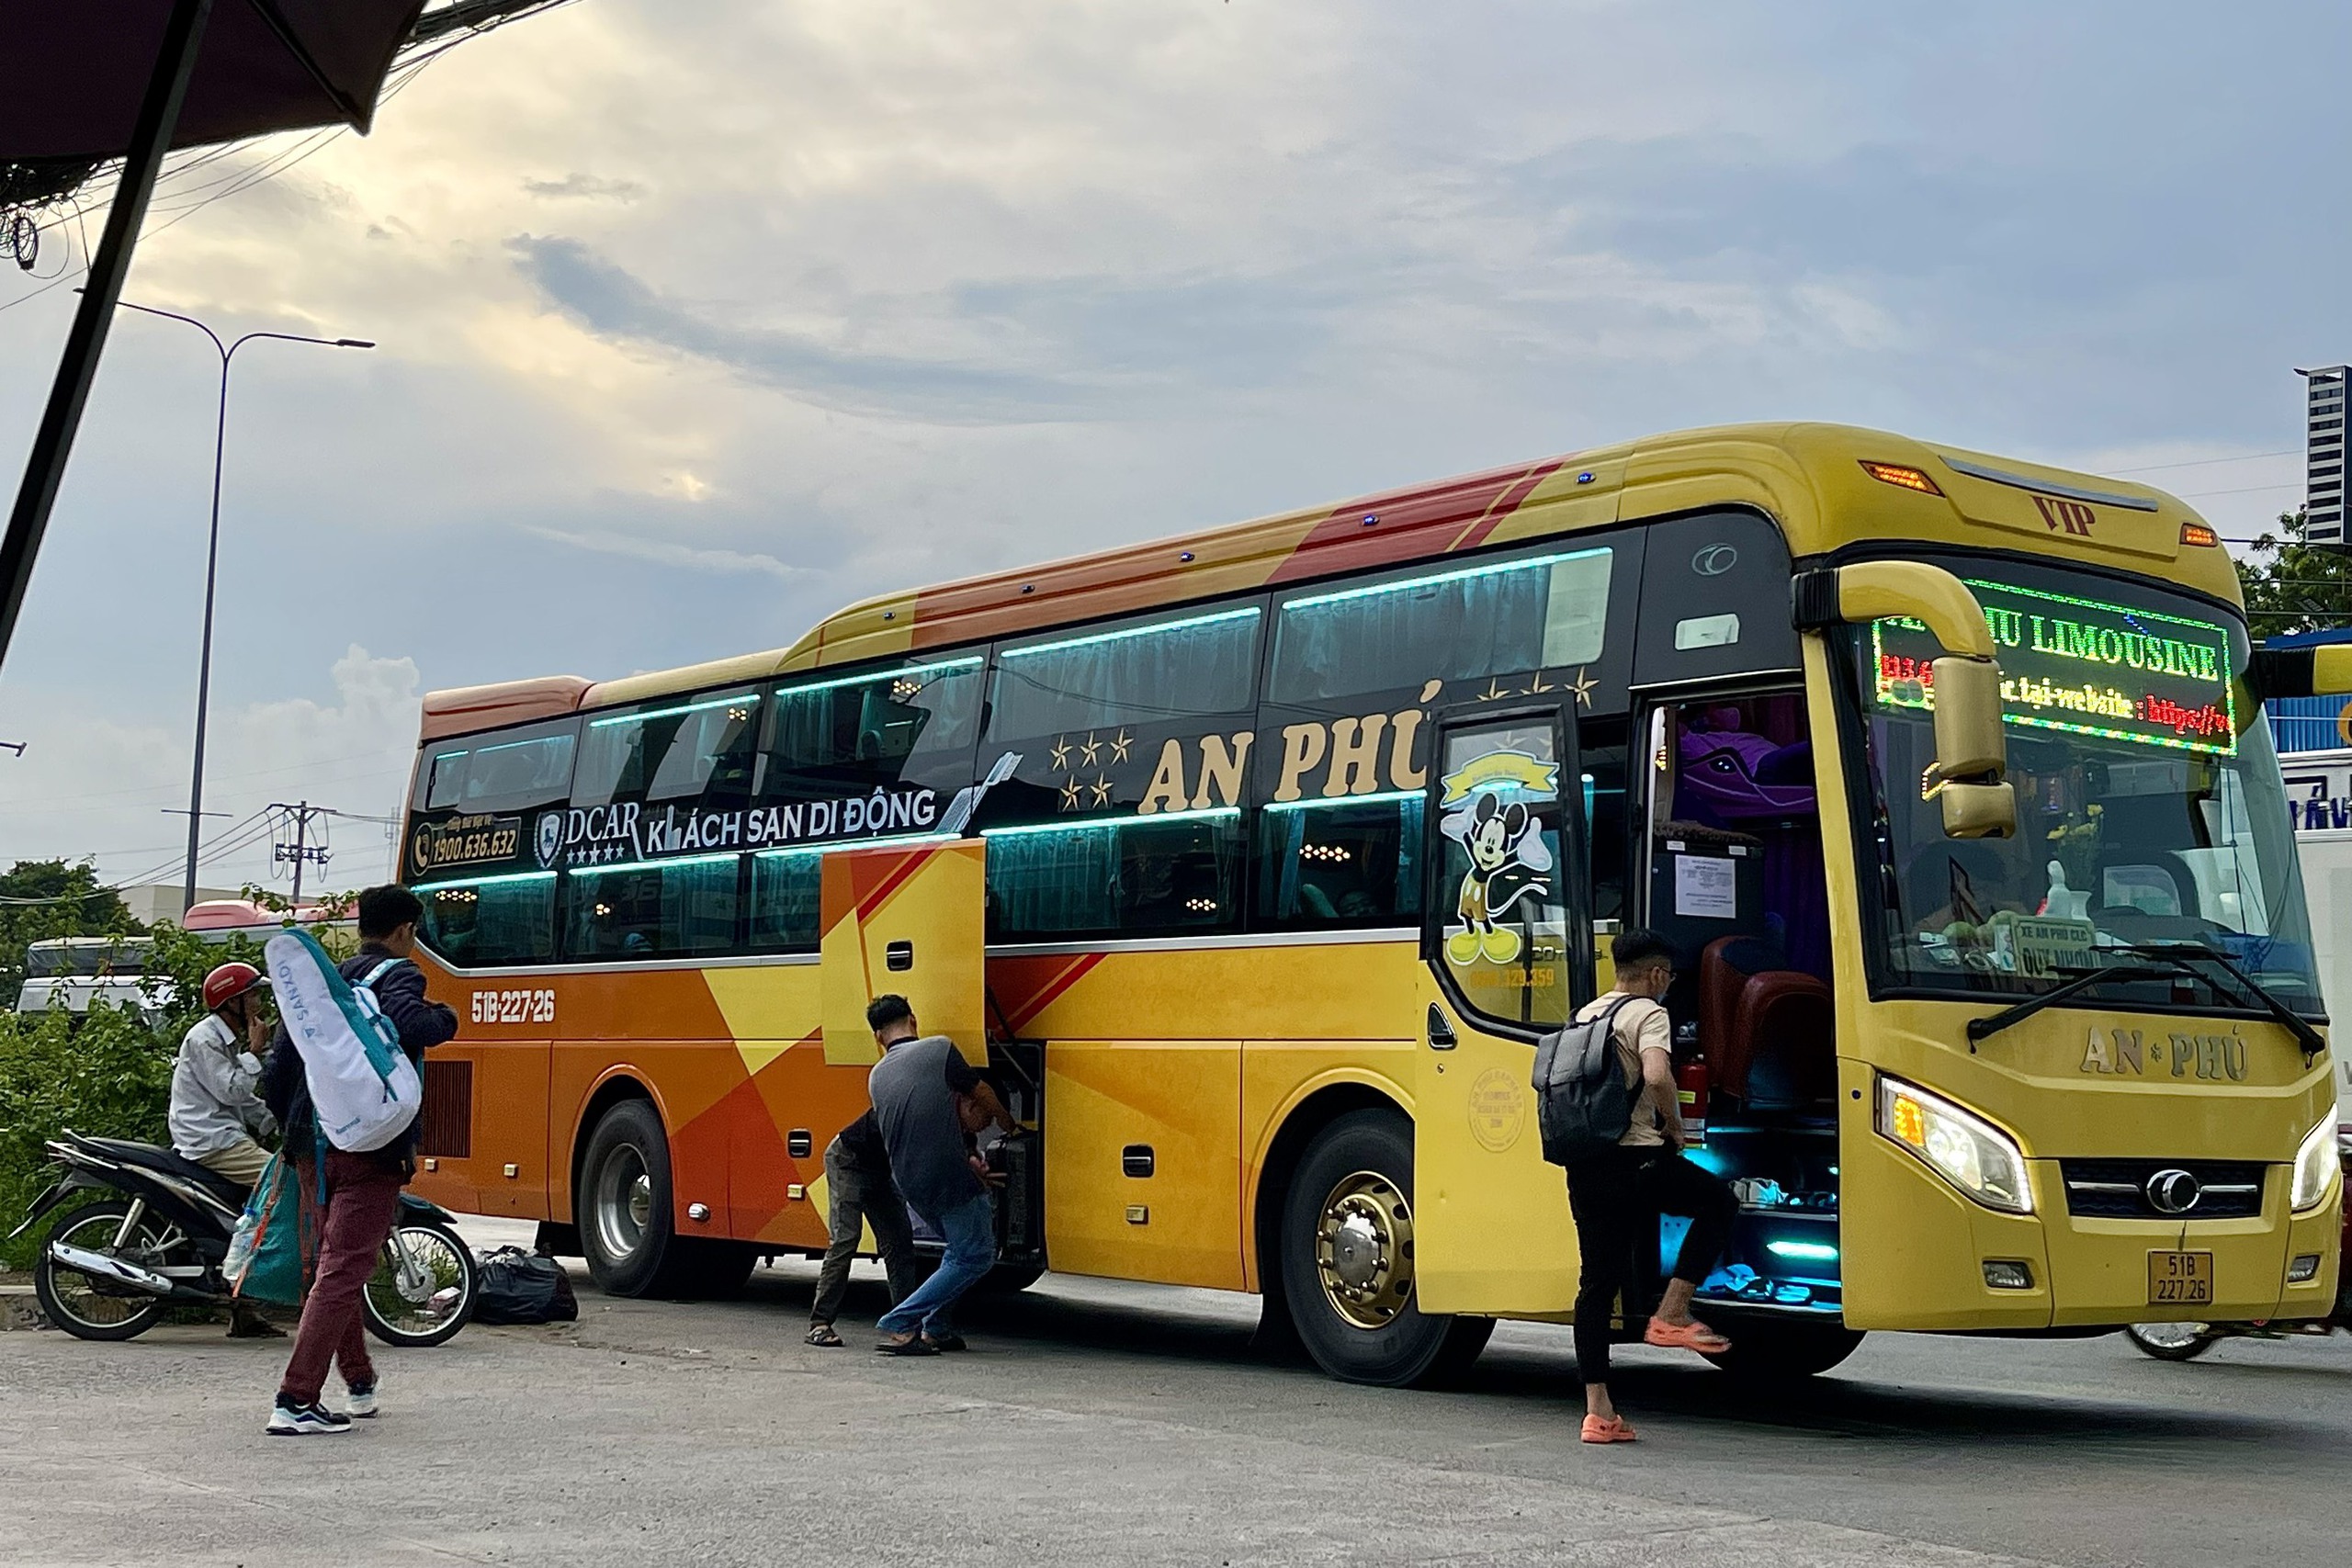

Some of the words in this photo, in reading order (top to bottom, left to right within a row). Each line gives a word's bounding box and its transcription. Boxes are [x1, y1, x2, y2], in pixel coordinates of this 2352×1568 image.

[2030, 495, 2096, 537] VIP
[2030, 615, 2219, 682] LIMOUSINE
[1137, 732, 1255, 814] AN
[565, 802, 642, 862] DCAR
[746, 805, 804, 847] SẠN
[808, 800, 837, 837] DI
[843, 786, 935, 837] ĐỘNG
[434, 829, 516, 863] 1900.636.632
[2080, 1026, 2143, 1075] AN
[2168, 1024, 2249, 1081] PHÚ
[2157, 1279, 2207, 1301] 227.26
[2168, 1255, 2196, 1277] 51B
